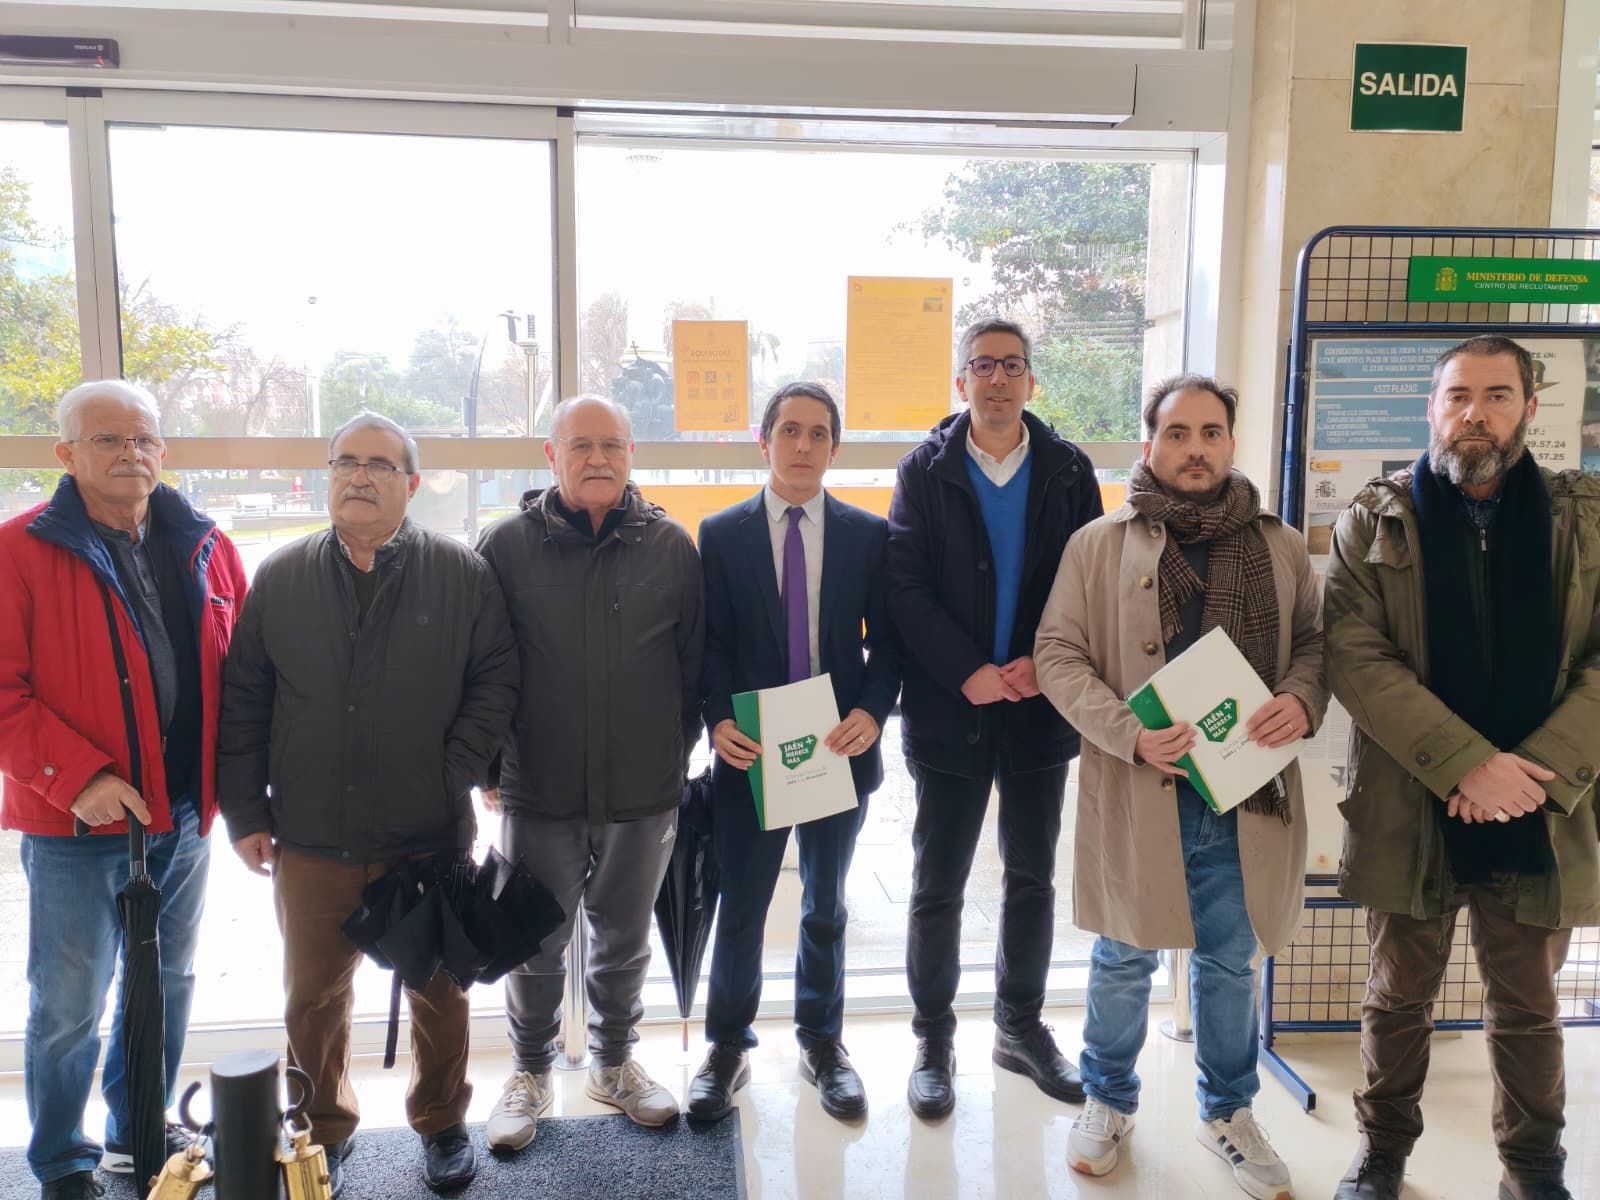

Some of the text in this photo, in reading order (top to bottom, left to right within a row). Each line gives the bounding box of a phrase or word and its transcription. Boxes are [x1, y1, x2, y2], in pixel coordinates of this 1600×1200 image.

[1359, 71, 1458, 97] SALIDA
[1465, 271, 1588, 283] MINISTERIO DE DEFENSA
[1519, 283, 1578, 291] RECLUTAMIENTO
[1527, 428, 1545, 436] LF.:
[1525, 440, 1566, 449] 29.57.24
[1203, 710, 1224, 729] JAÉN
[1207, 713, 1233, 734] MERECE
[1212, 726, 1227, 739] MÁS
[783, 741, 804, 753] JAÉN
[785, 747, 809, 757] MERECE
